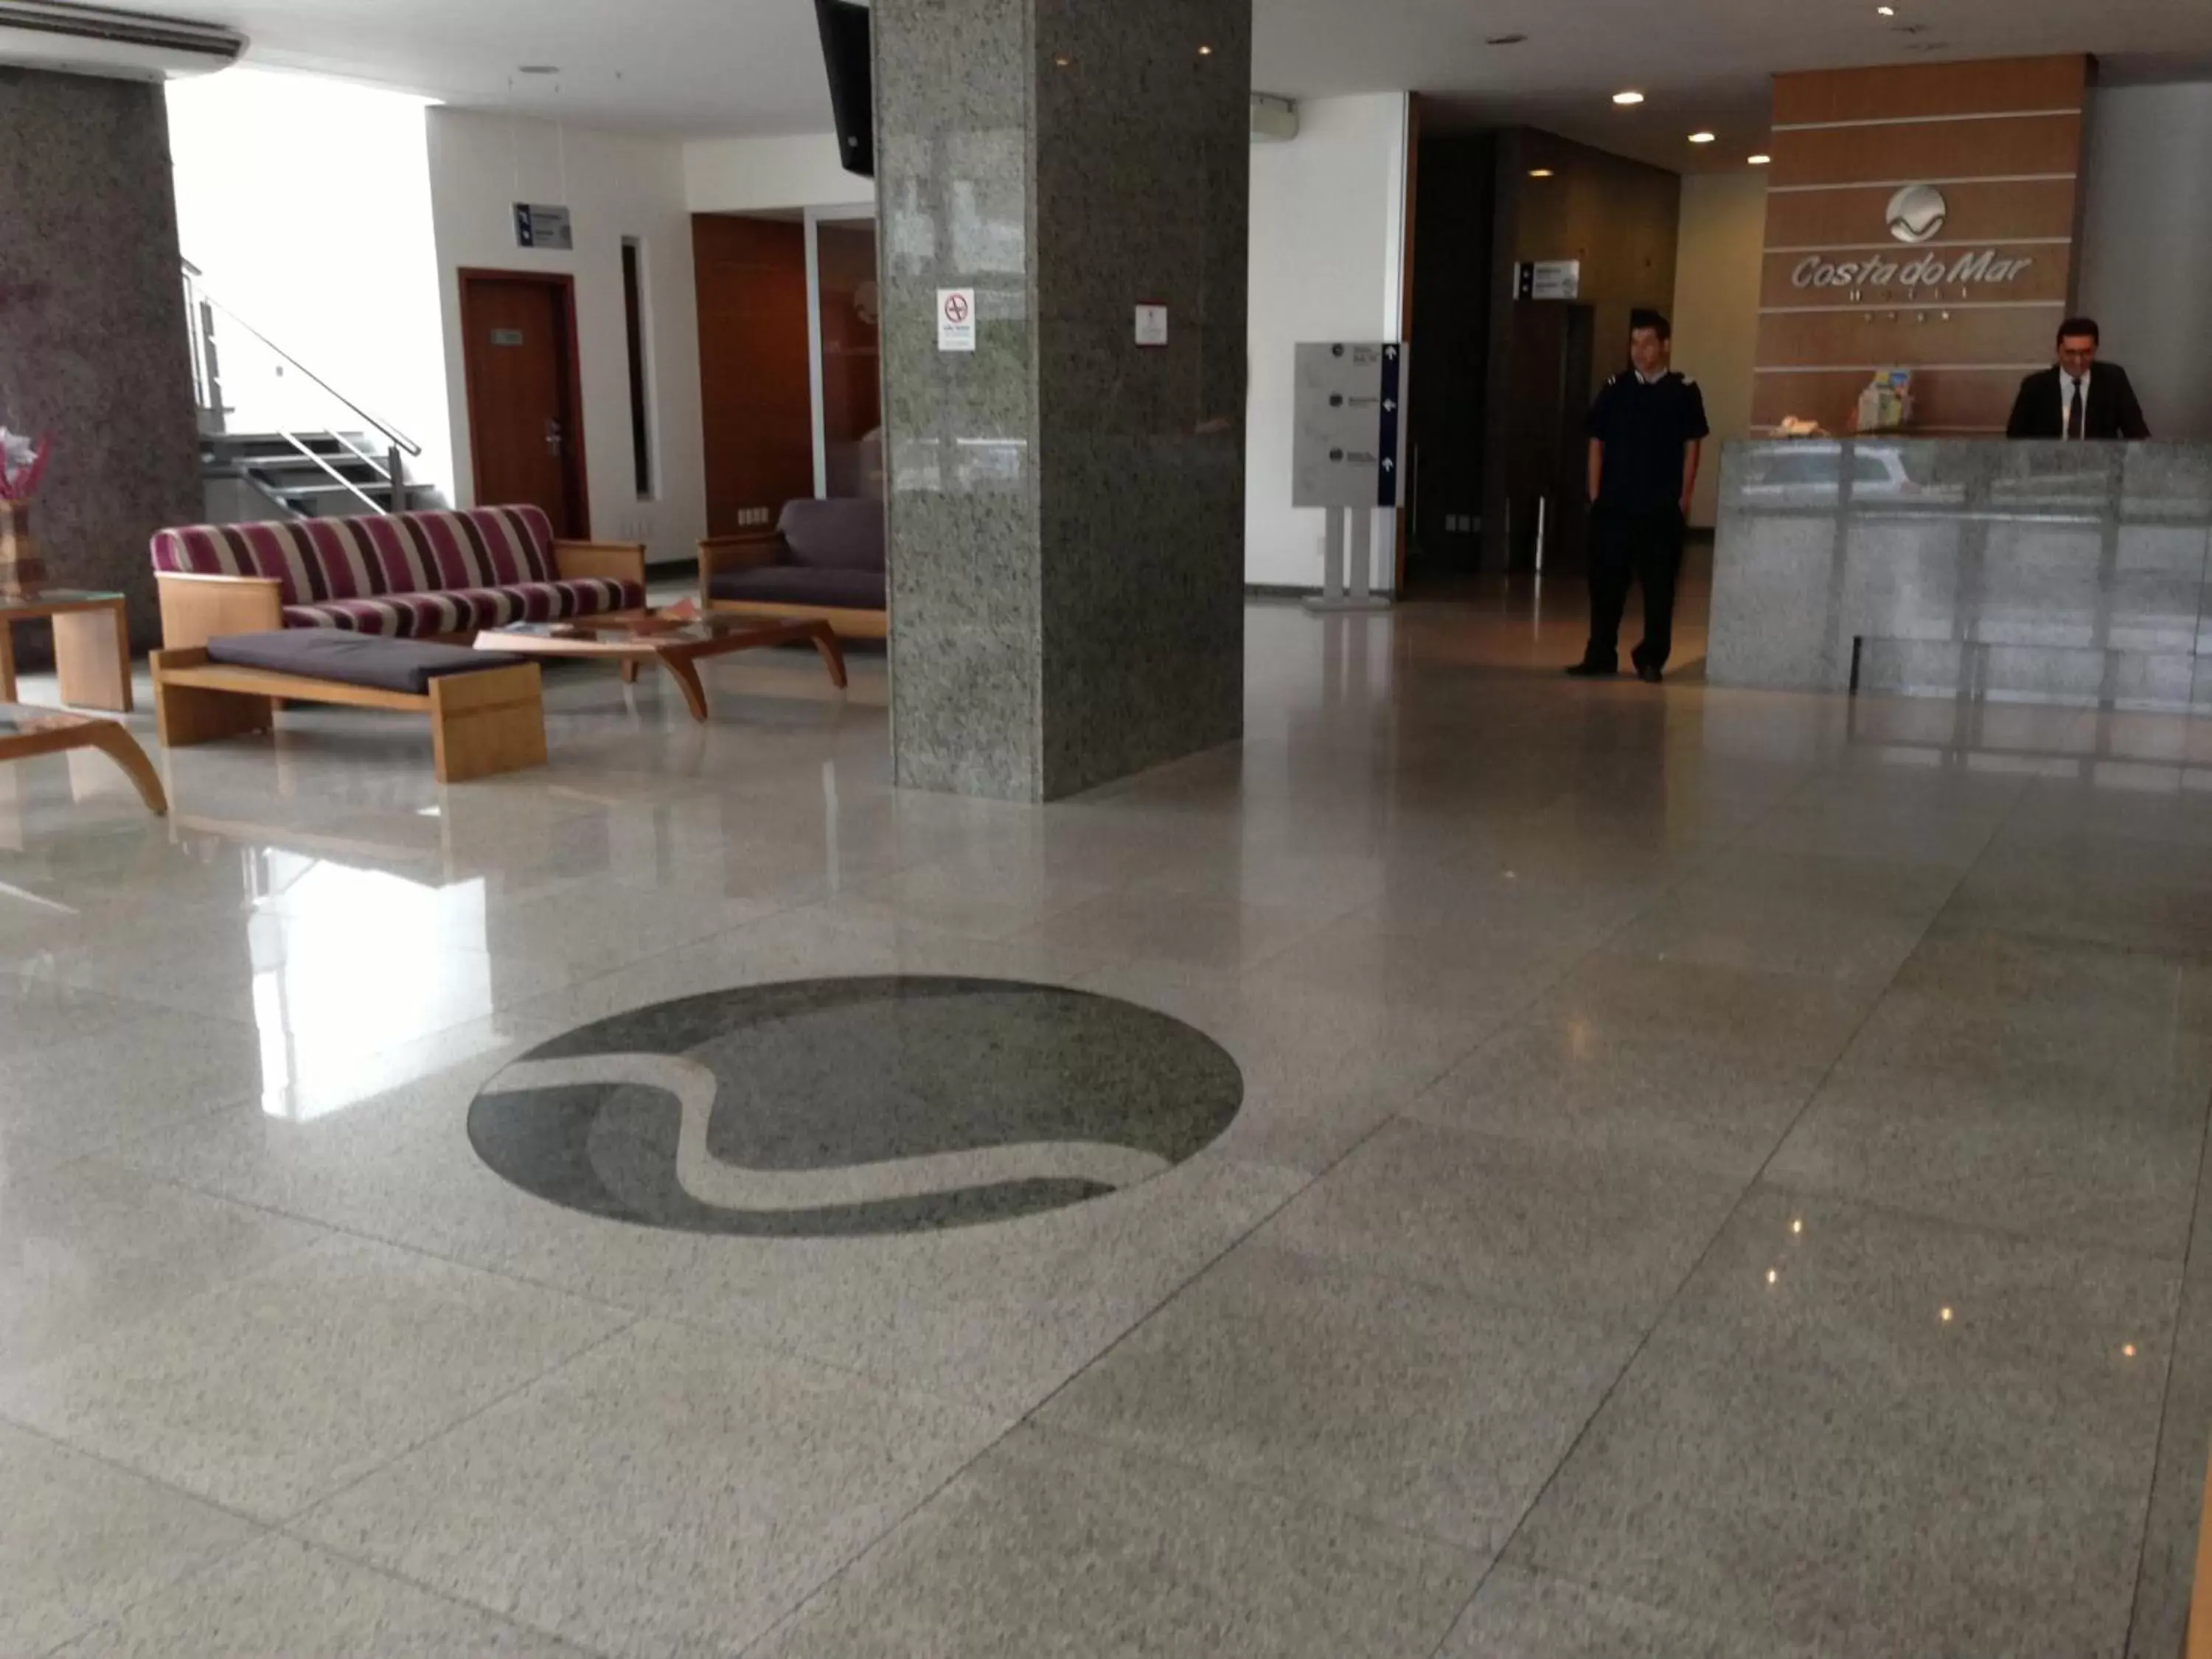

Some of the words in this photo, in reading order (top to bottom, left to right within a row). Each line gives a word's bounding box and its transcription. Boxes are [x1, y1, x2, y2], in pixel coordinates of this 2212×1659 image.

[1792, 255, 1899, 288] Costa
[1899, 251, 1946, 285] do
[1946, 250, 2033, 284] Mar
